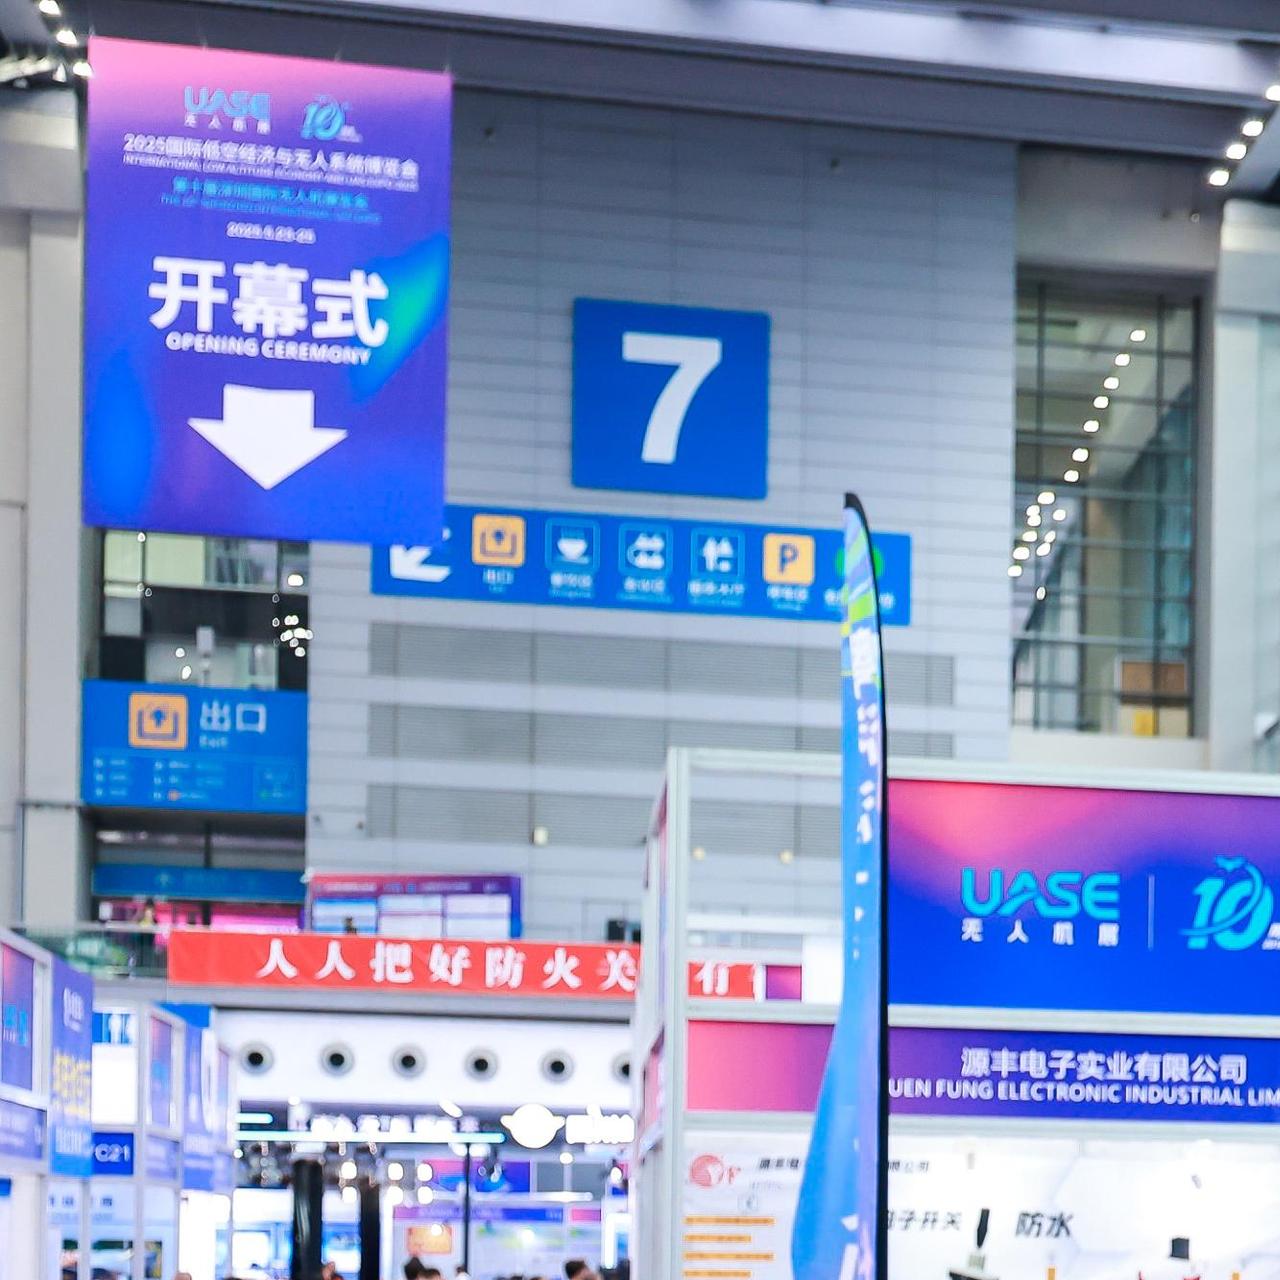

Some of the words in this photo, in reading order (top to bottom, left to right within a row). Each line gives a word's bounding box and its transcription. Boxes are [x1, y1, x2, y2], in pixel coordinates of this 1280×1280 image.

[148, 255, 390, 348] 开幕式
[165, 331, 259, 357] OPENING
[261, 339, 372, 365] CEREMONY
[621, 331, 723, 464] 7
[200, 699, 267, 734] 出口
[960, 867, 1121, 920] UASE
[960, 918, 1120, 948] 无人机展
[257, 938, 638, 997] 人人把好防火关
[960, 1045, 1249, 1086] 源丰电子实业有限公司
[935, 1078, 993, 1102] FUNG
[997, 1081, 1120, 1105] ELECTRONIC
[1124, 1085, 1245, 1107] INDUSTRIAL
[1014, 1210, 1078, 1240] 防水
